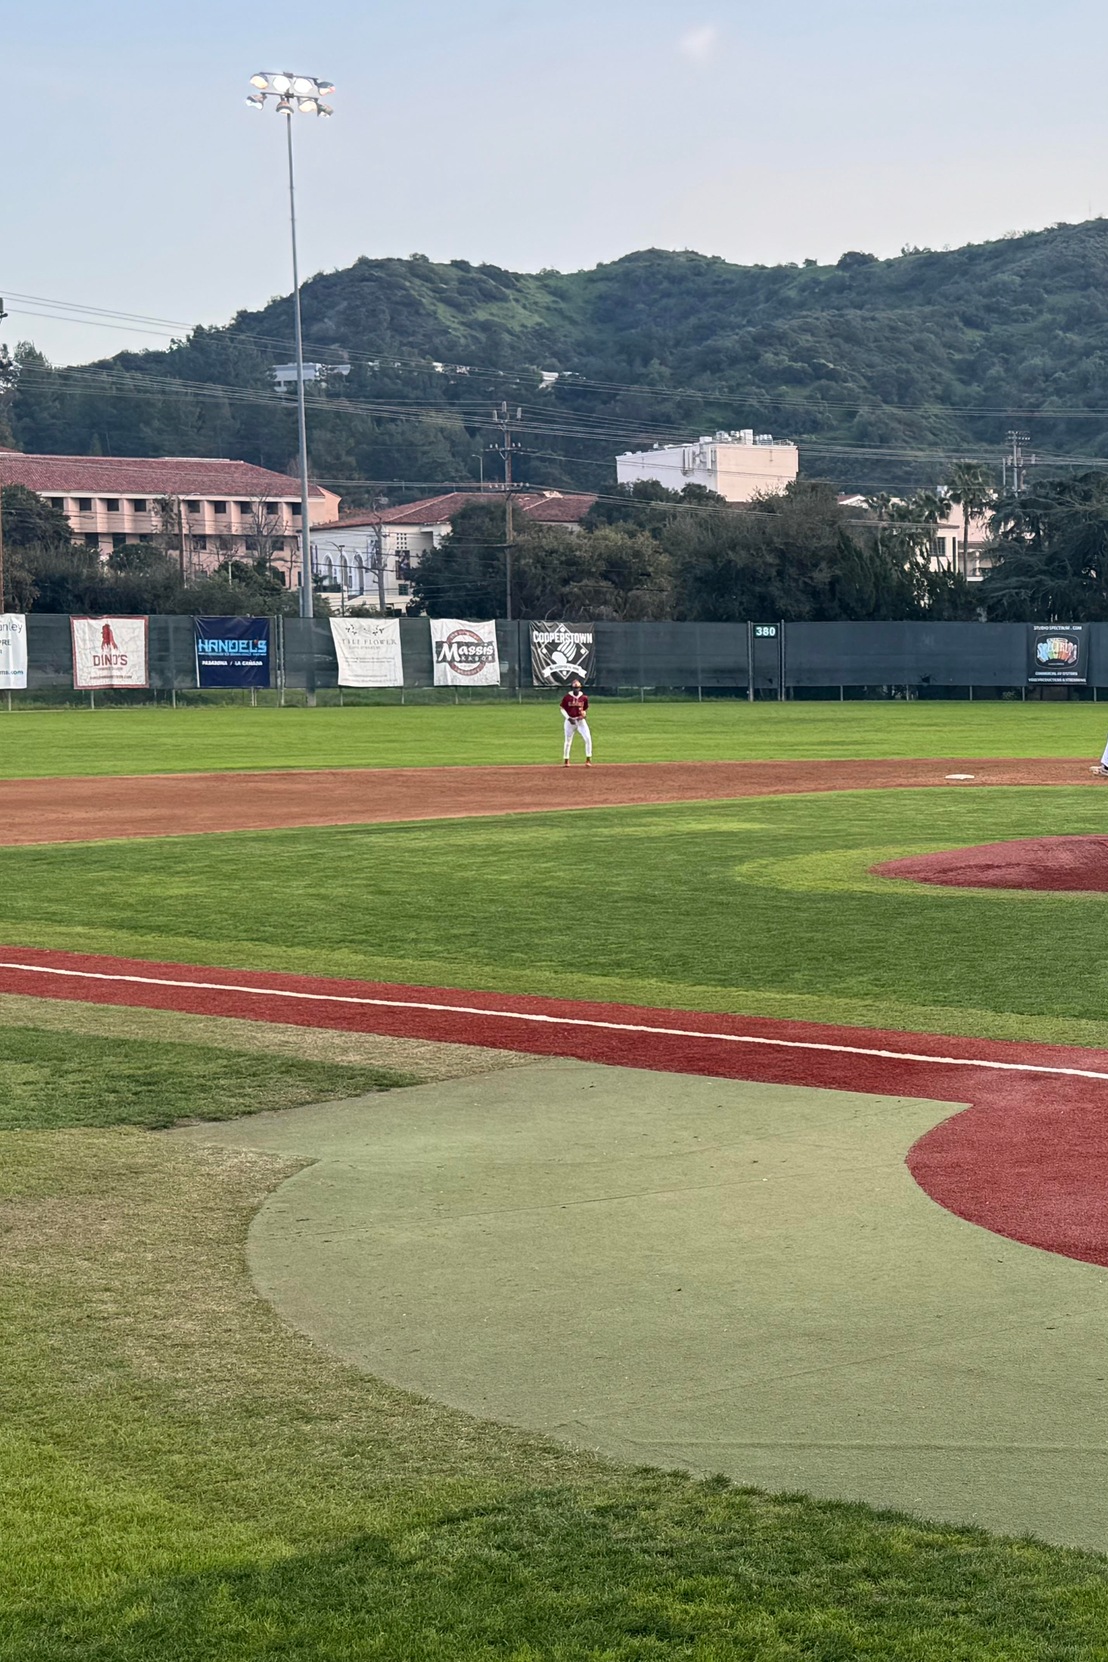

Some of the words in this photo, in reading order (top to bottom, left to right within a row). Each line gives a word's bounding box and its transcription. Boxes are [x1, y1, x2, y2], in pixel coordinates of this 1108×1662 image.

[532, 630, 593, 644] COOPERSTOWN
[755, 627, 776, 636] 380
[198, 639, 267, 653] HANDEL'S
[437, 642, 494, 663] Massis
[92, 654, 128, 667] DINO'S
